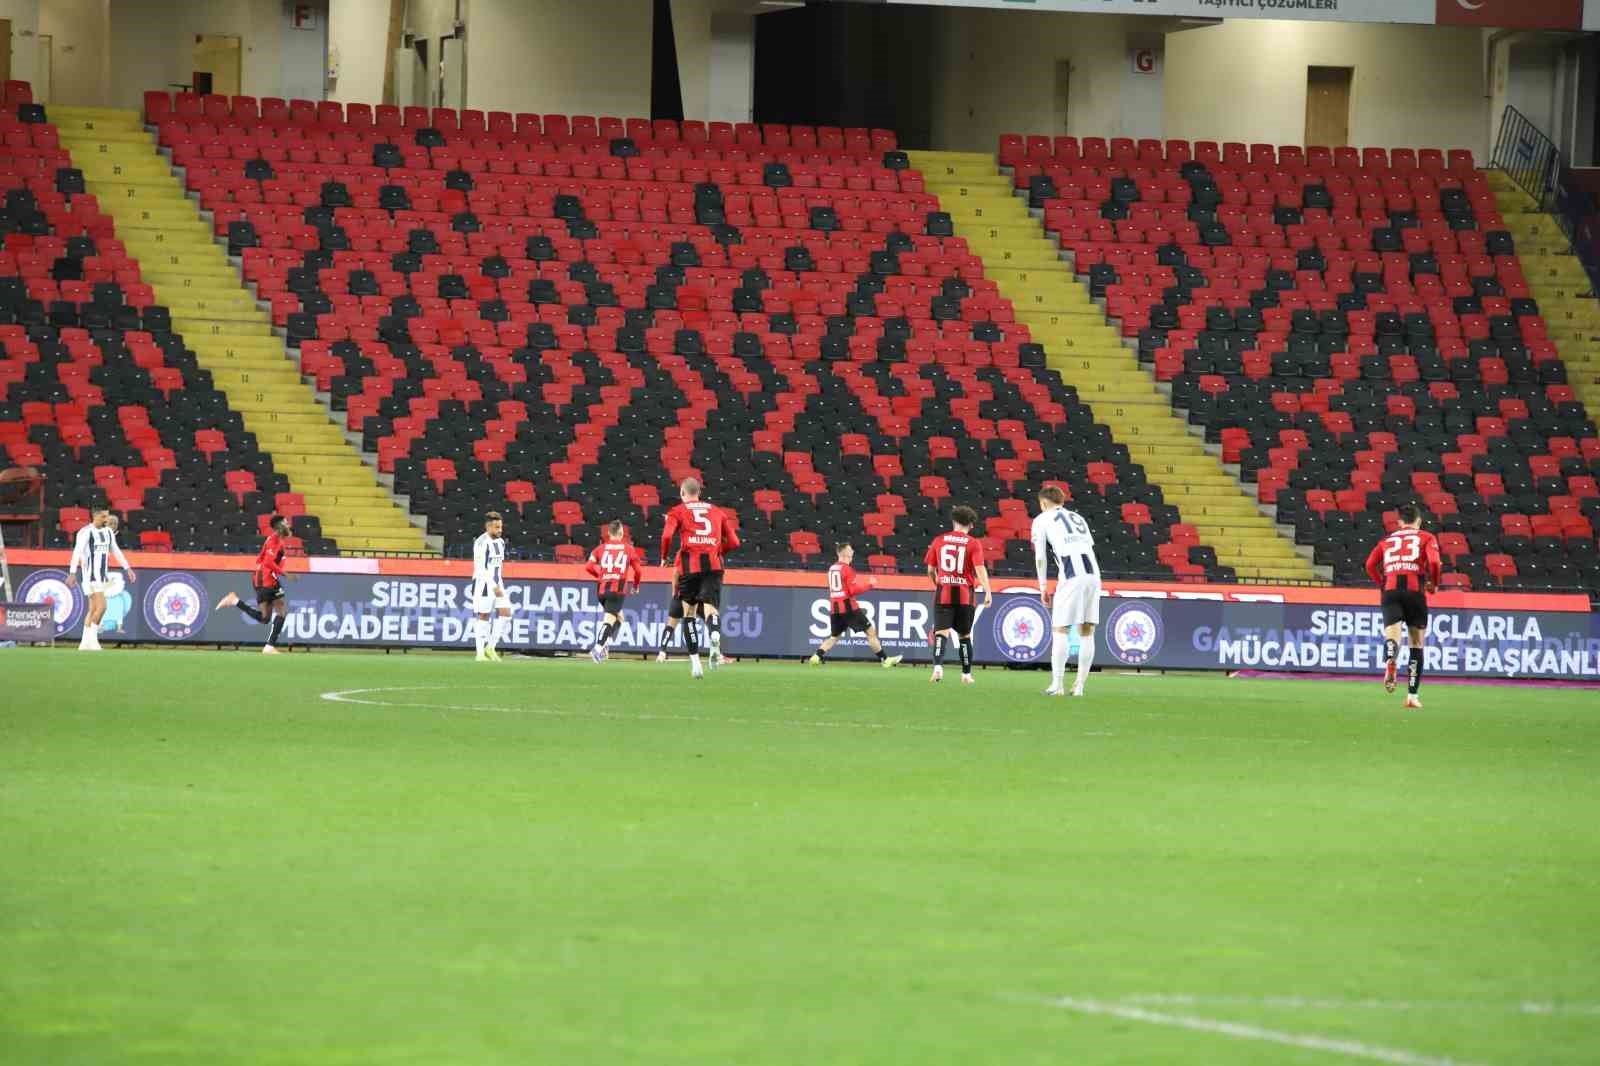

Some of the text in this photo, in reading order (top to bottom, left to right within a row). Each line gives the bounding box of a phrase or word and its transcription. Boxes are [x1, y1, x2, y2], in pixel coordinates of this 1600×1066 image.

[692, 510, 712, 535] 5
[1053, 511, 1088, 534] 19
[601, 550, 628, 573] 44
[940, 544, 966, 574] 61
[1384, 535, 1420, 563] 23
[1218, 635, 1370, 669] MÜCADELE
